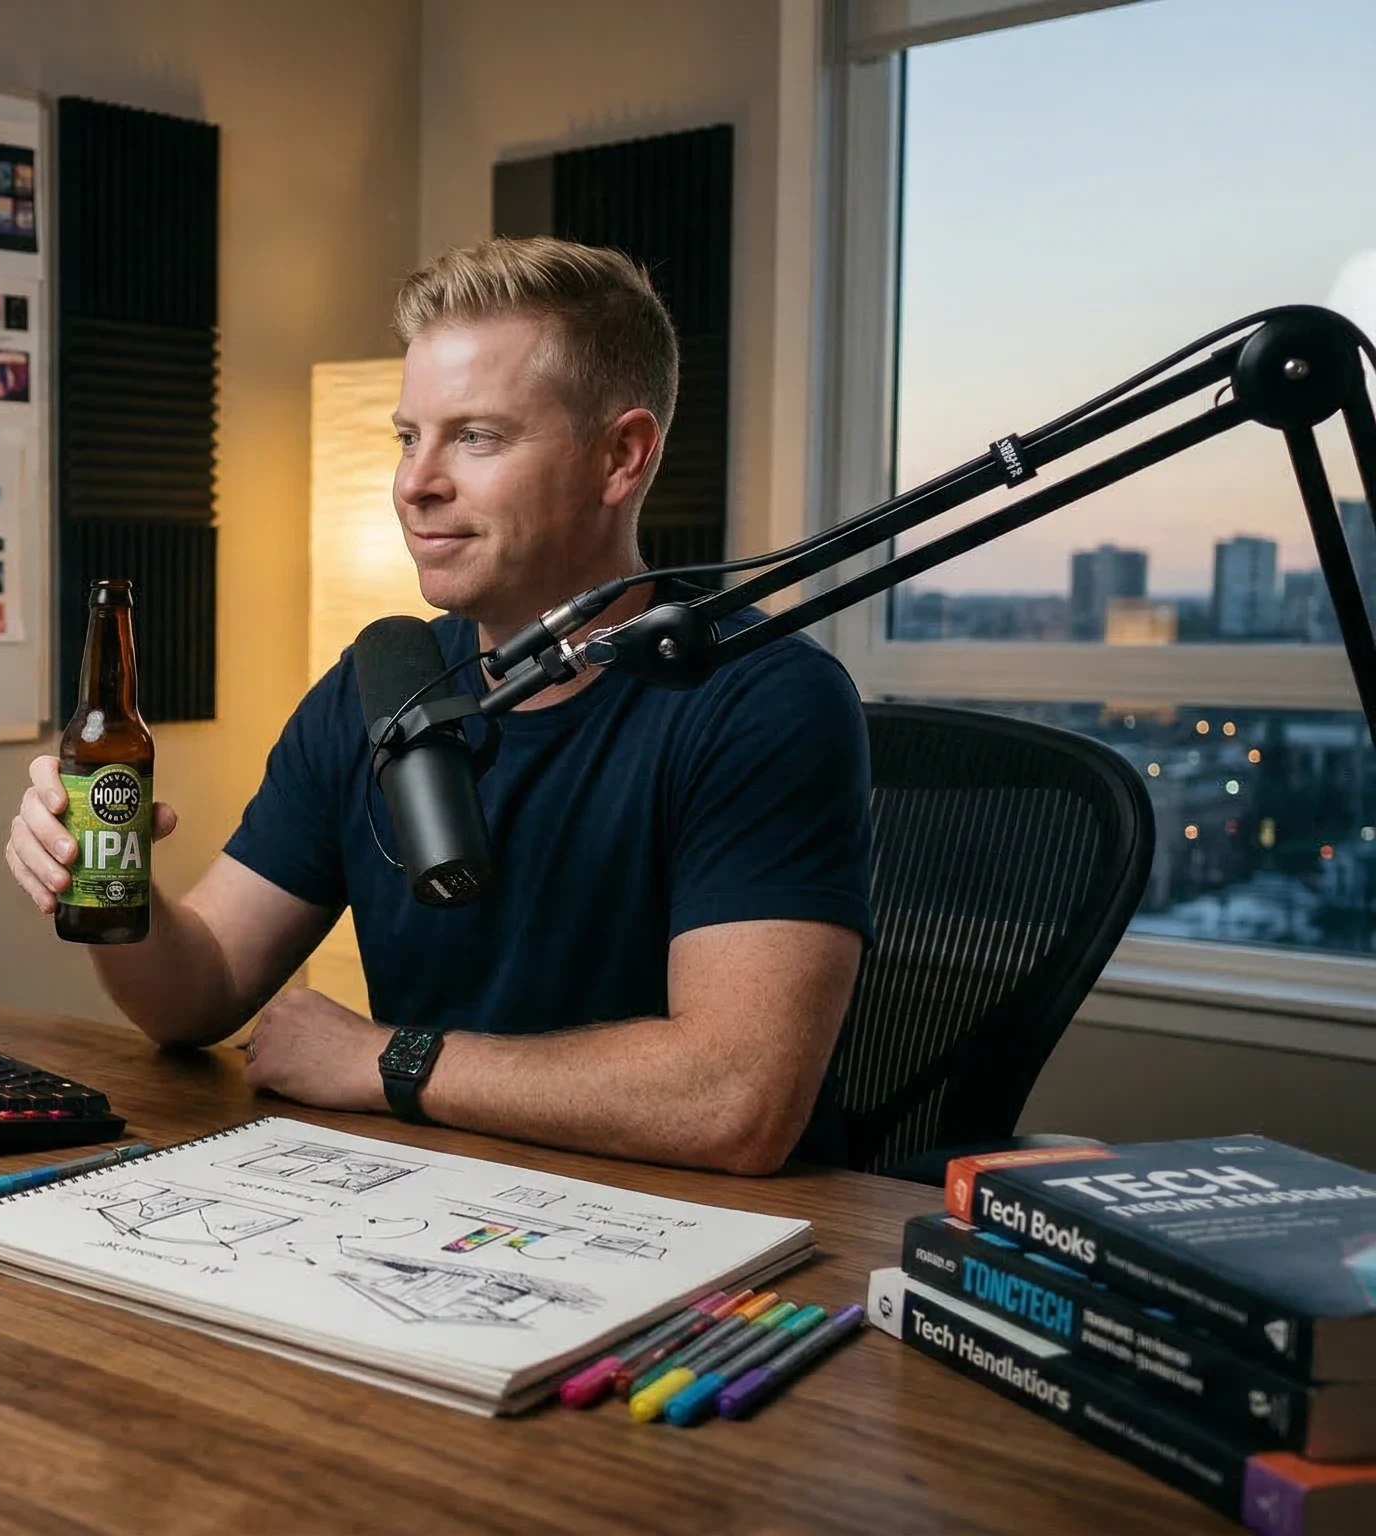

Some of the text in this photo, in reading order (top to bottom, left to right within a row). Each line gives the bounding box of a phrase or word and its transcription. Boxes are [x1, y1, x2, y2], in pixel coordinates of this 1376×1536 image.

[94, 787, 138, 805] HOOPS
[84, 830, 142, 870] IPA
[1043, 1166, 1280, 1202] TECH
[980, 1187, 1026, 1233] Tech
[1030, 1209, 1097, 1264] Books
[912, 1309, 955, 1351] Tech
